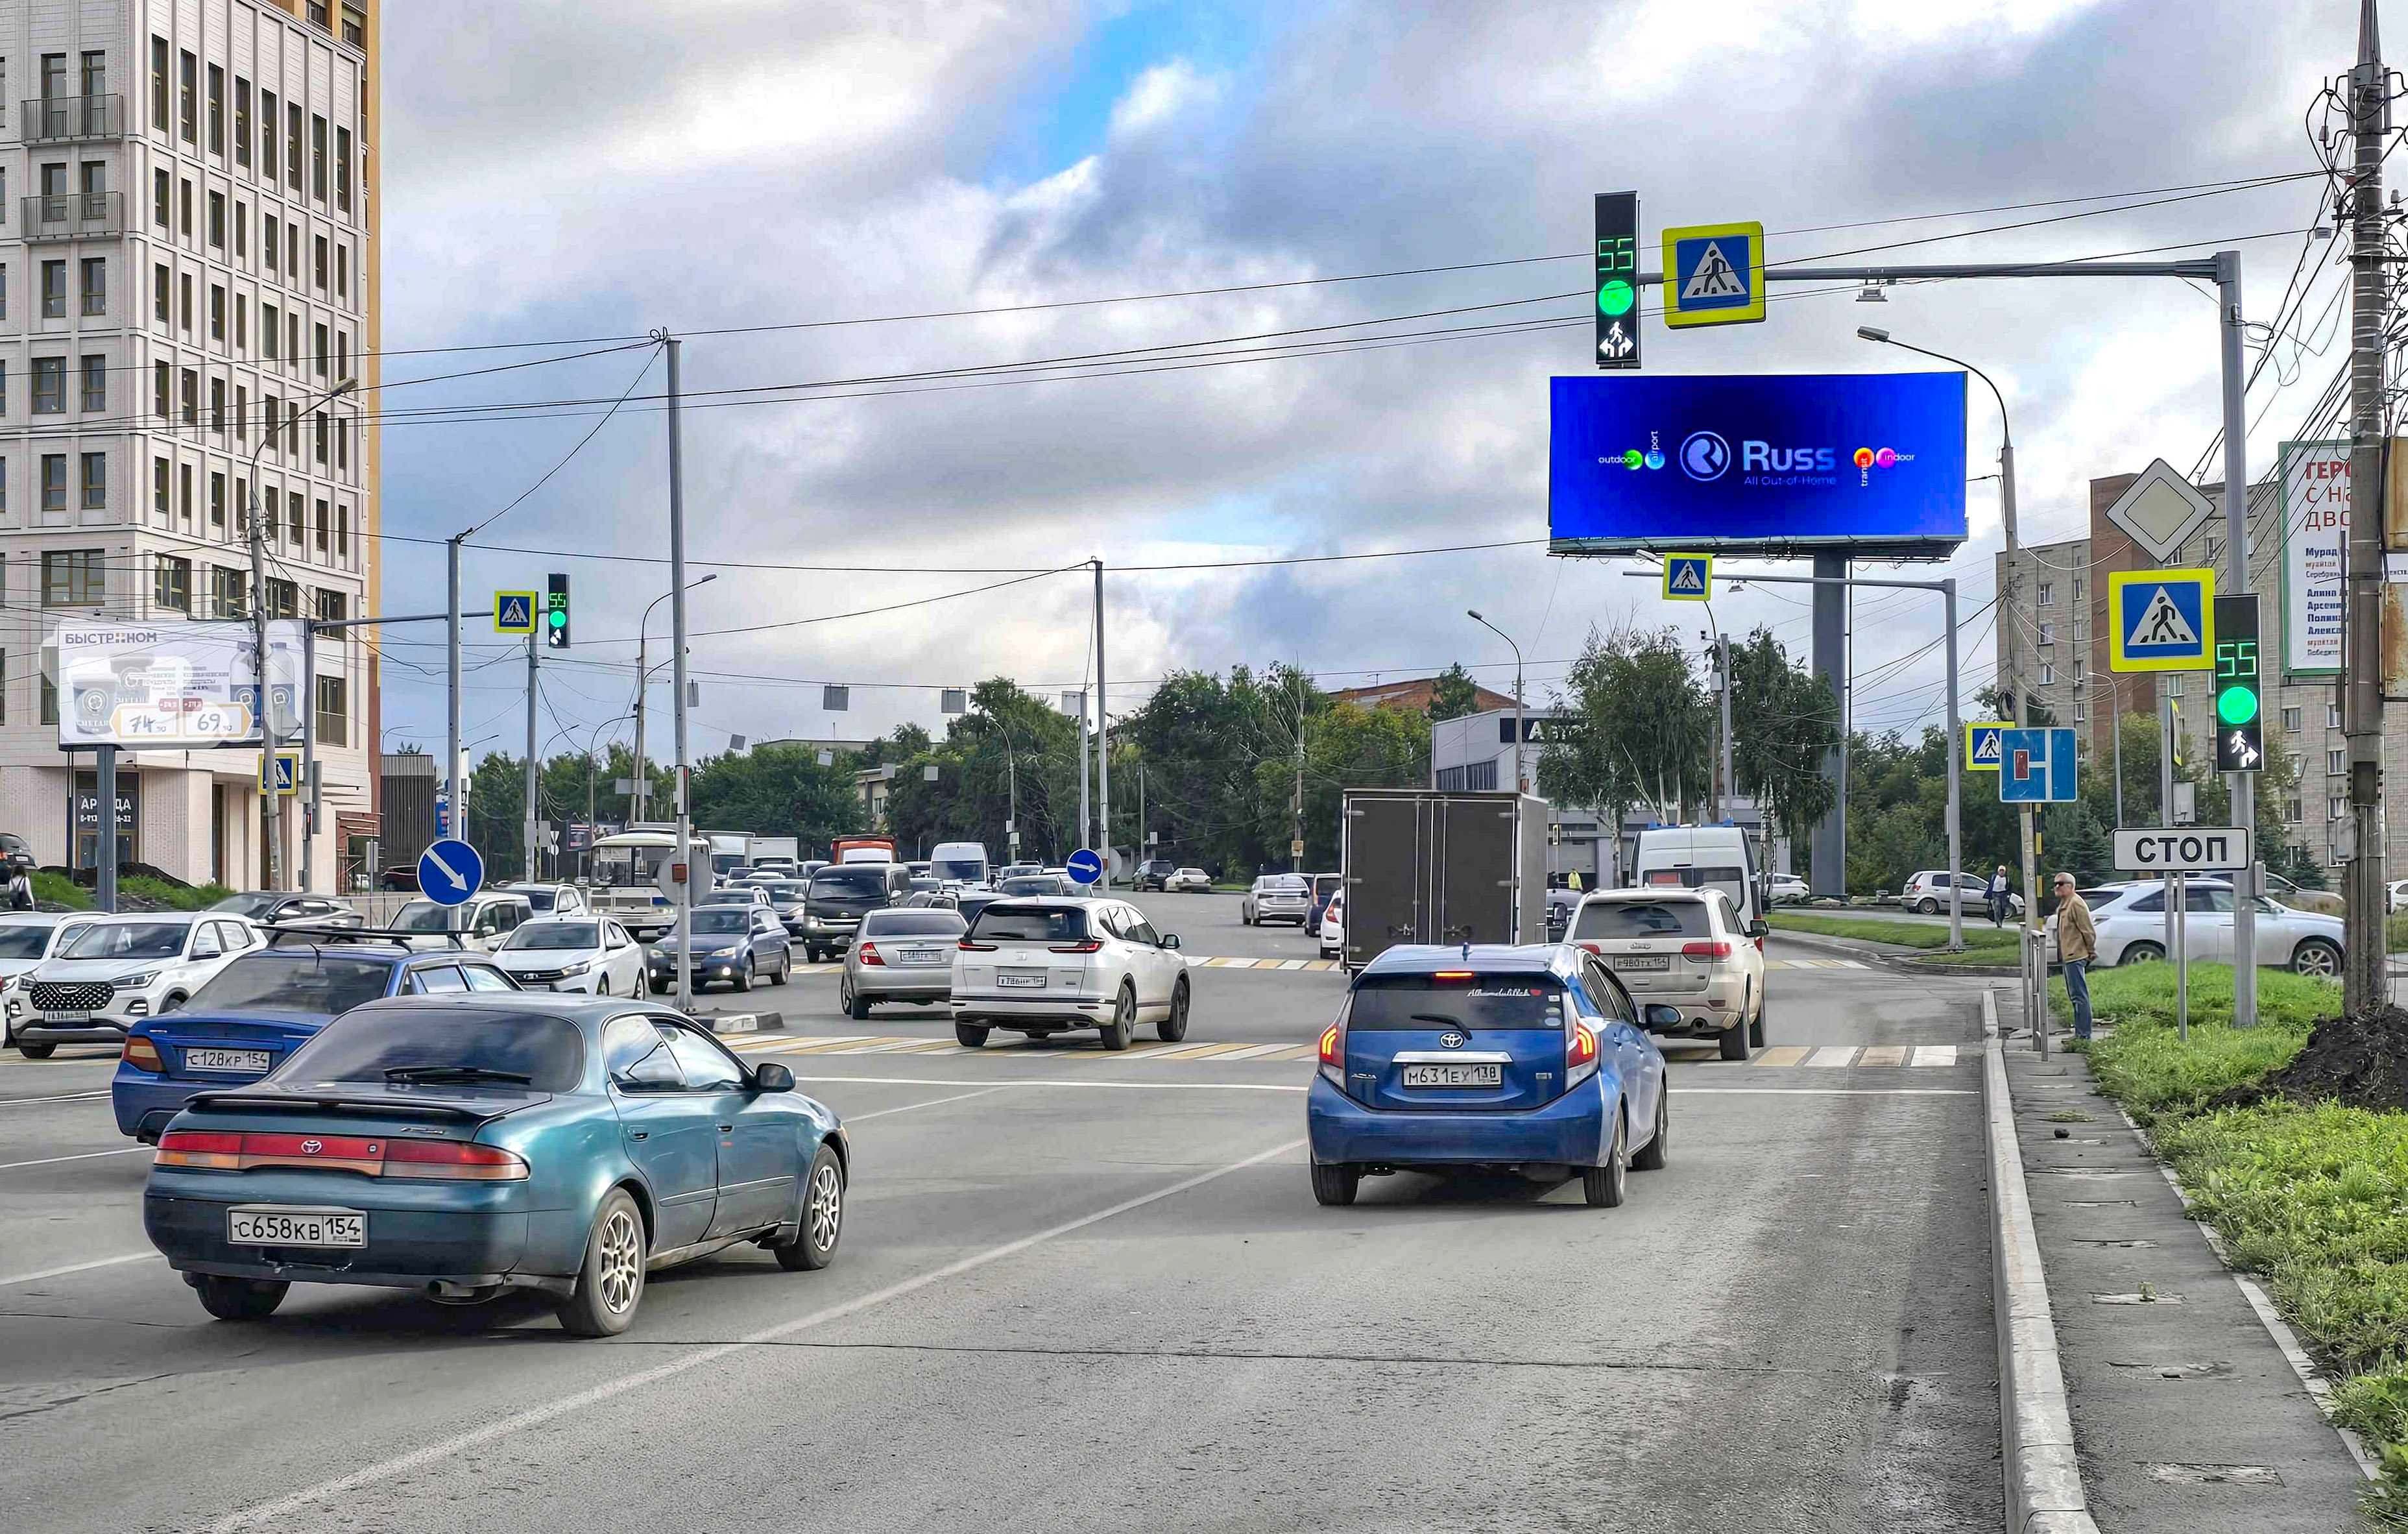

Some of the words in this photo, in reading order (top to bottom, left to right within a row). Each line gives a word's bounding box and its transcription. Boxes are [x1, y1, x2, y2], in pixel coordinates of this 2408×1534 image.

[1598, 237, 1633, 270] 55
[1598, 456, 1636, 464] outdoor
[1742, 441, 1836, 471] Russ
[1884, 453, 1916, 462] indoor
[1744, 476, 1759, 486] All
[549, 592, 566, 607] 55
[2307, 589, 2337, 597] Алина
[2307, 602, 2346, 611] Арсени
[2308, 626, 2343, 635] Алекса
[2217, 642, 2257, 677] 55
[130, 714, 156, 733] 74
[197, 712, 221, 731] 69
[81, 797, 132, 812] АРДА
[2135, 836, 2228, 863] СТОП
[1474, 1067, 1496, 1080] 138
[238, 1216, 320, 1241] С658КВ
[325, 1217, 361, 1236] 154
